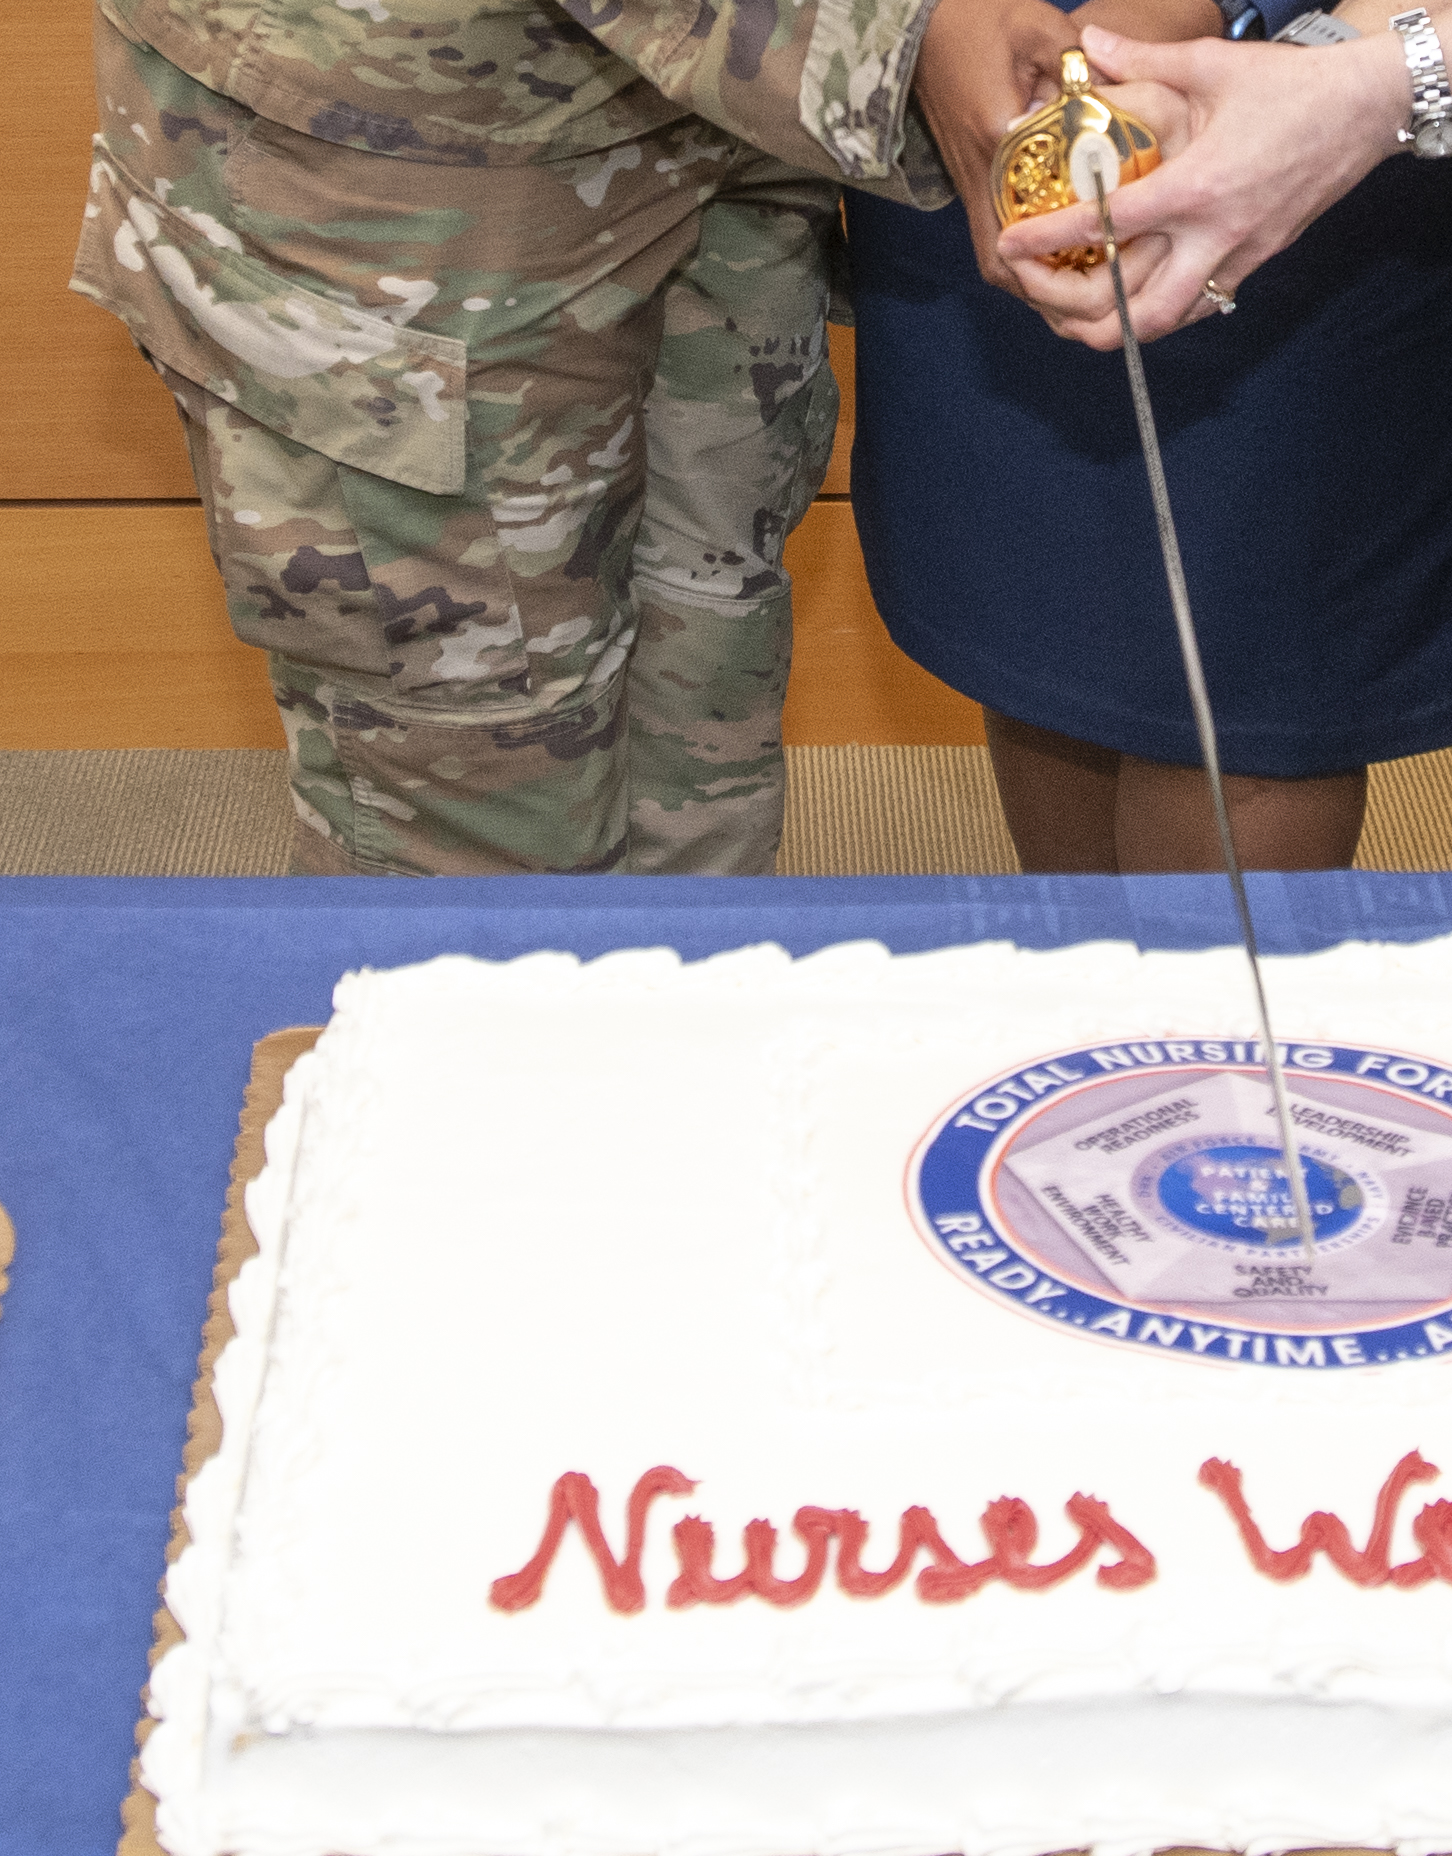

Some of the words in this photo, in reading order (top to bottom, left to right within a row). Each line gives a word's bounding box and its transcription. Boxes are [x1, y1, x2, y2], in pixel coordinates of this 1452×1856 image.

[955, 1062, 1084, 1133] TOTAL
[1090, 1043, 1334, 1071] NURSING
[1073, 1098, 1200, 1152] OPERATIONAL
[1099, 1109, 1201, 1155] READINESS
[1290, 1102, 1413, 1146] LEADERSHIP
[1040, 1184, 1131, 1266] ENVIRONMENT
[1094, 1192, 1155, 1243] HEALTHY
[1232, 1283, 1330, 1299] QUALITY
[1234, 1264, 1313, 1278] SAFETY
[1251, 1275, 1302, 1287] AND
[489, 1464, 1156, 1615] Nurses
